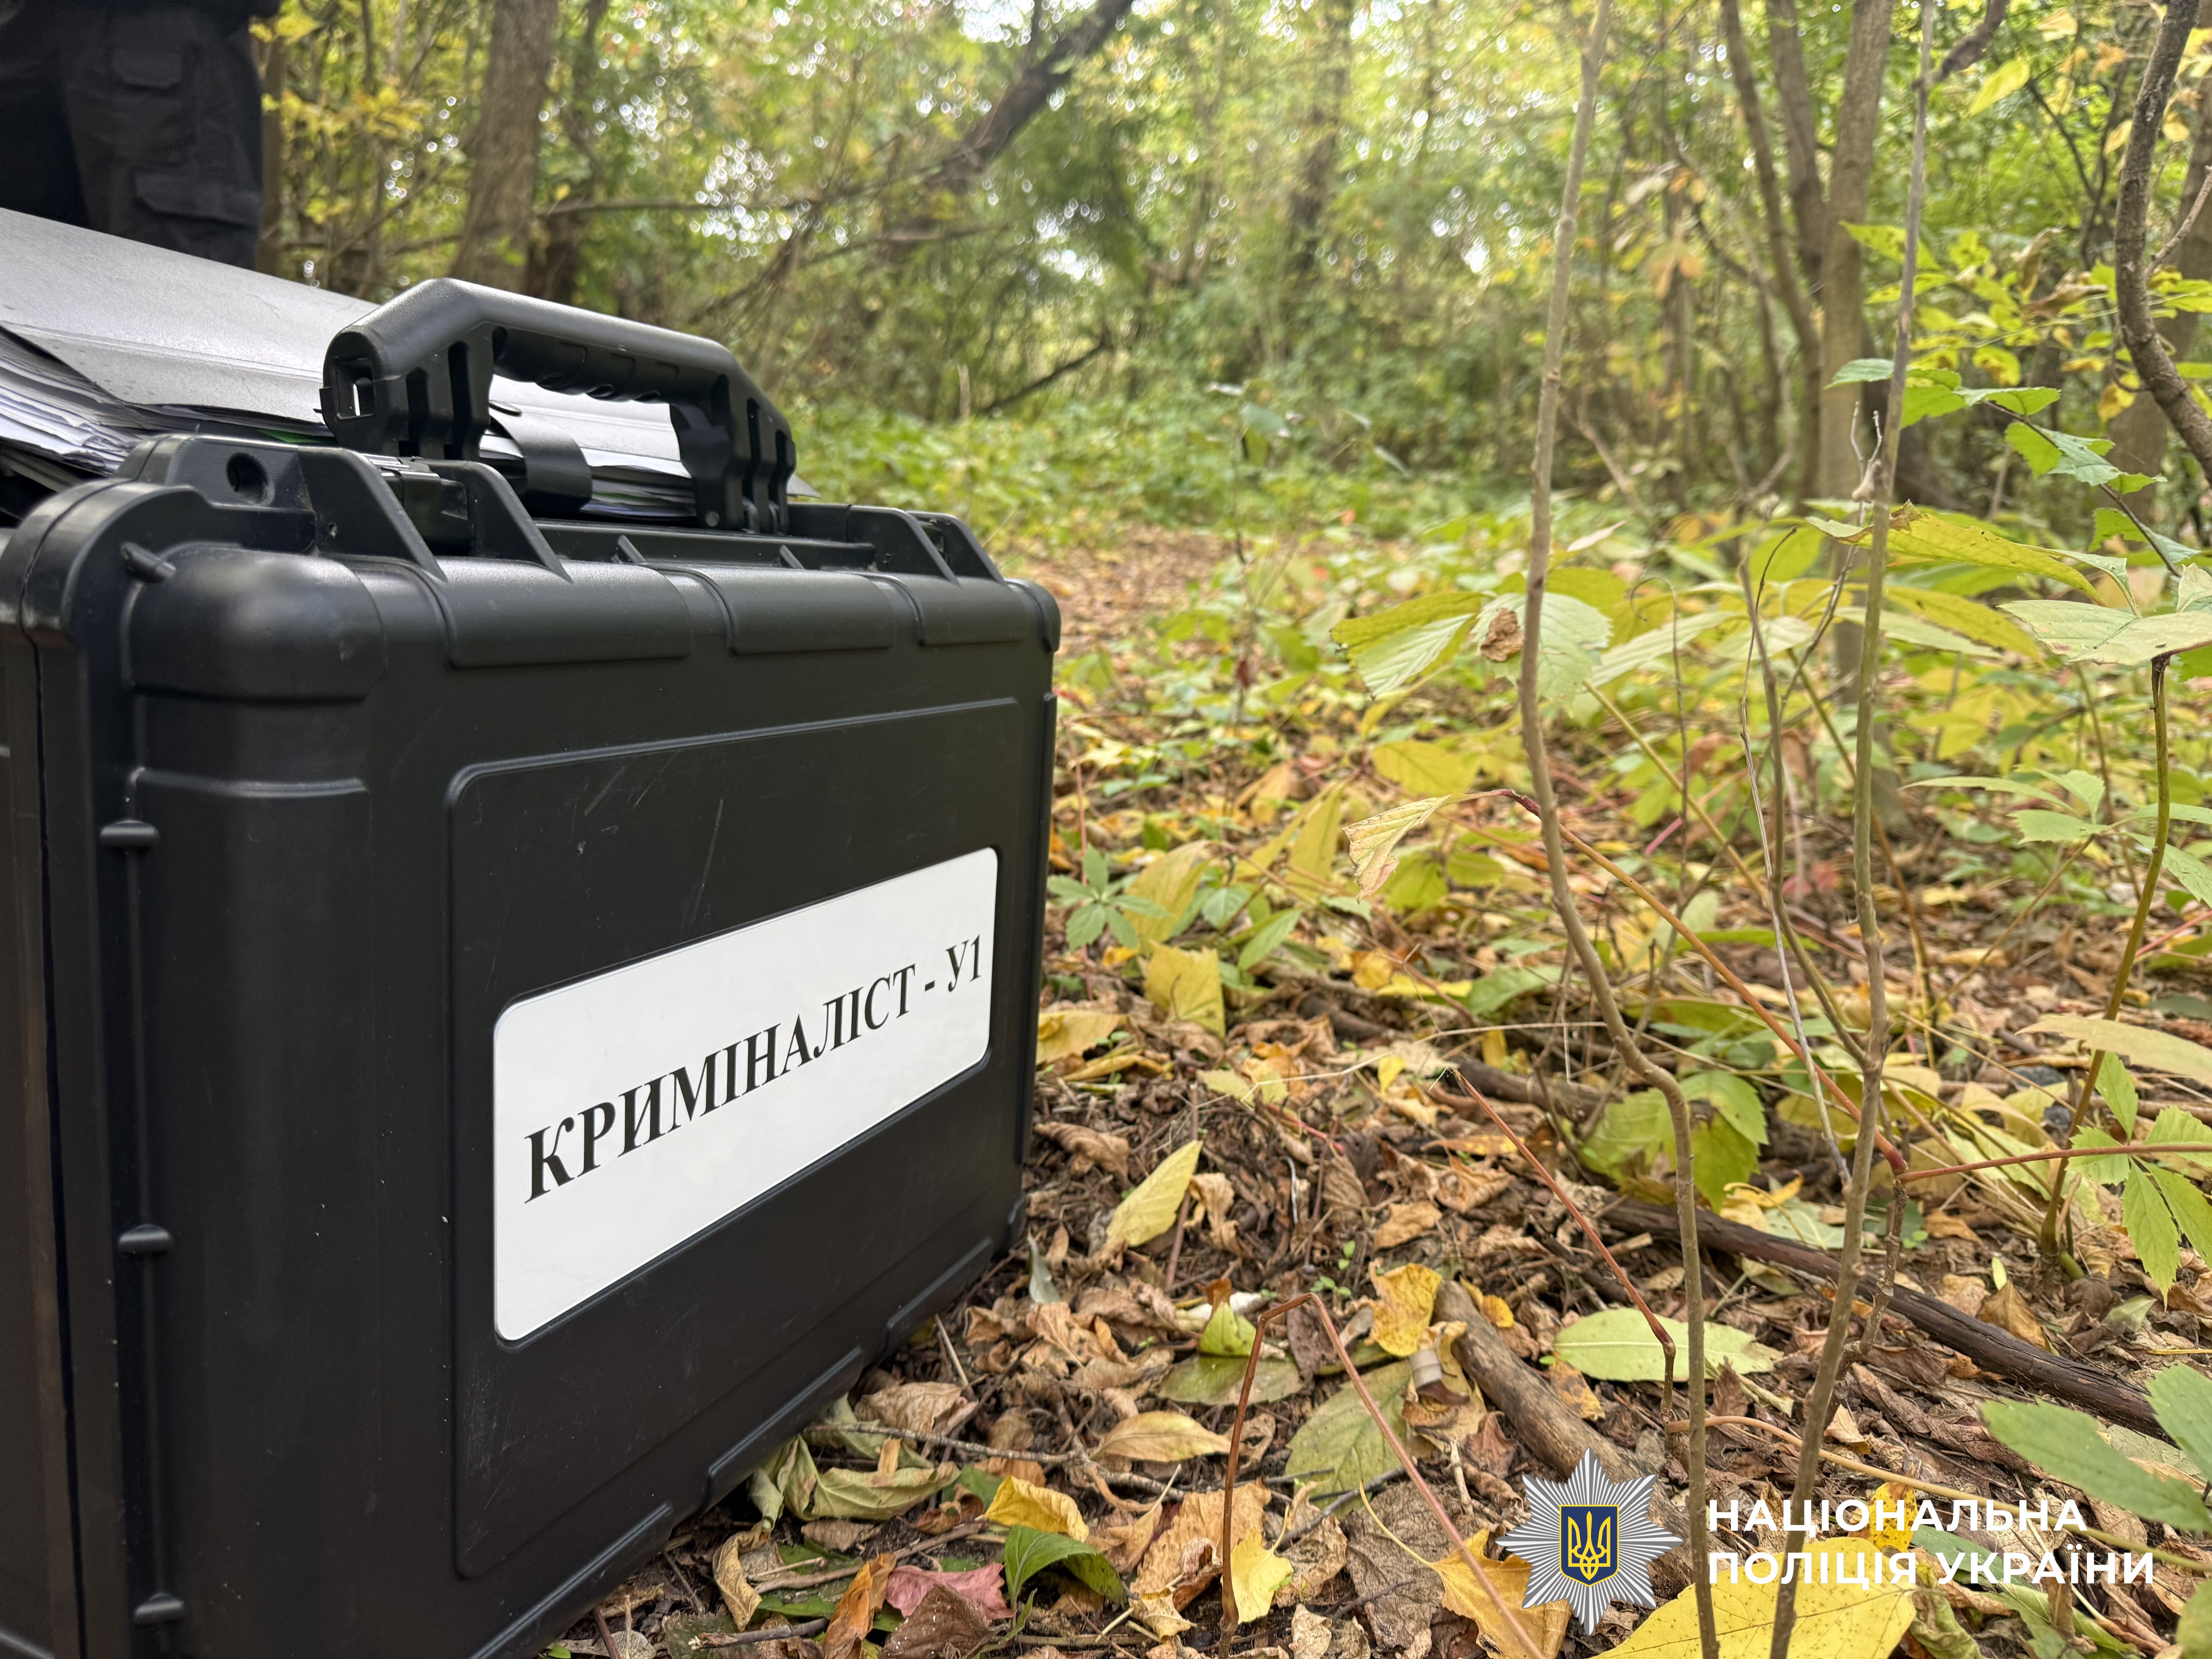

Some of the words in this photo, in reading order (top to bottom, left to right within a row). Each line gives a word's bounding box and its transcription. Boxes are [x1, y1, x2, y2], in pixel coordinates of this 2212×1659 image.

[524, 963, 915, 1204] КРИМІНАЛІСТ
[924, 980, 935, 992] -
[945, 935, 982, 993] У1
